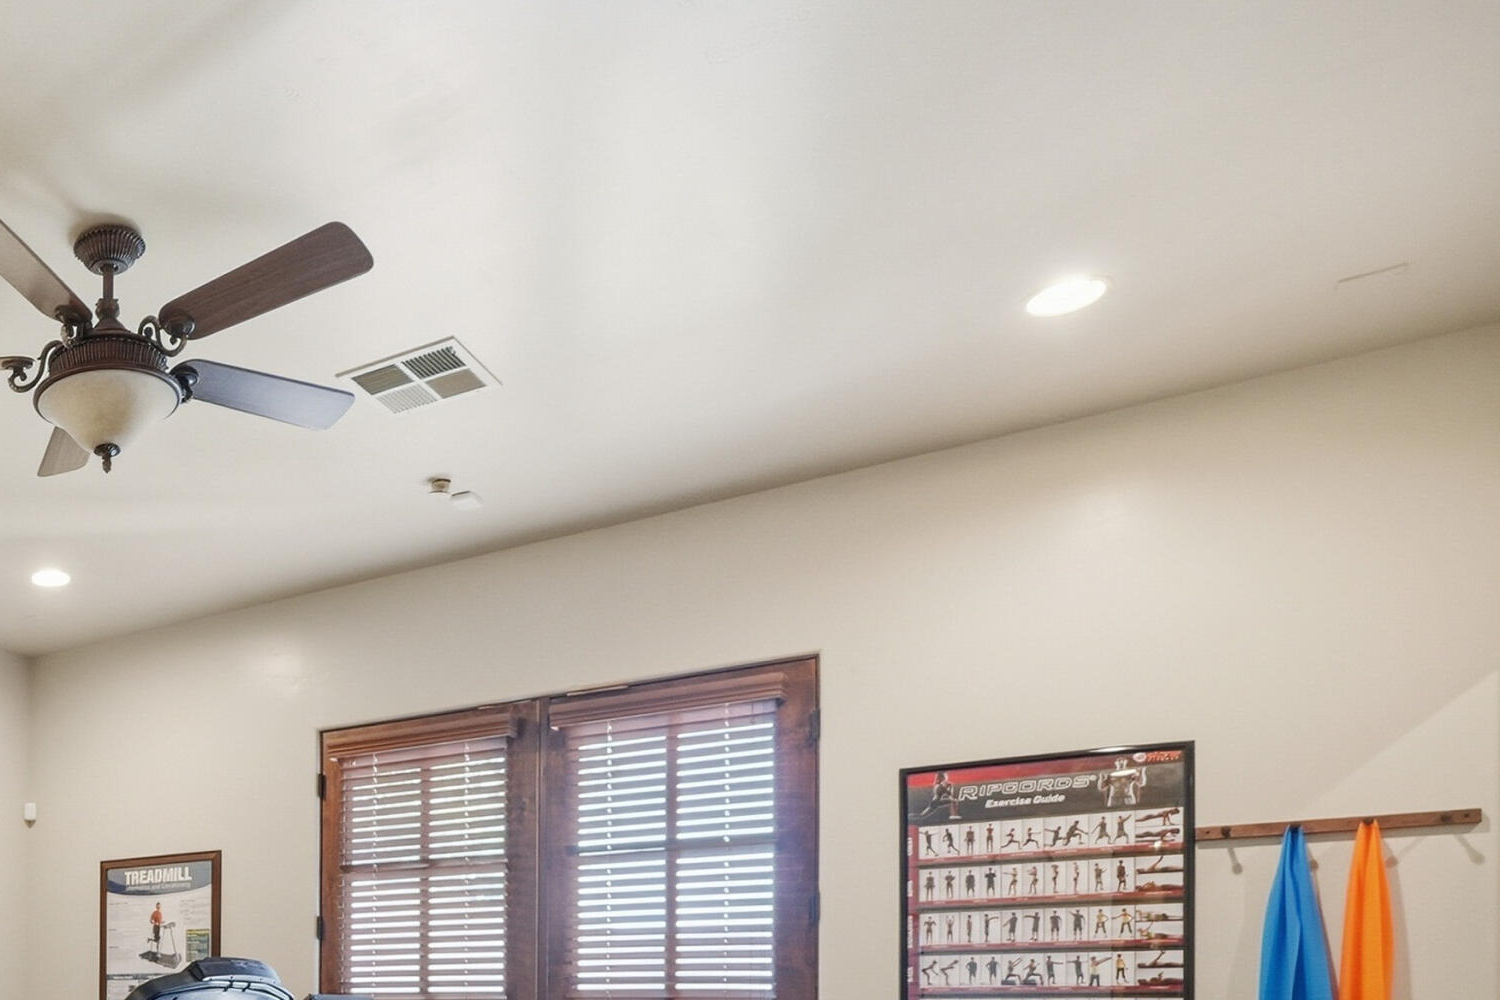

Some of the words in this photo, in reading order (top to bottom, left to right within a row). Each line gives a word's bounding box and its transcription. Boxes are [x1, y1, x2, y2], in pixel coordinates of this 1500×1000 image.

[985, 796, 1031, 809] Exercise
[1033, 793, 1066, 806] Guide
[124, 866, 192, 886] TREADMILL
